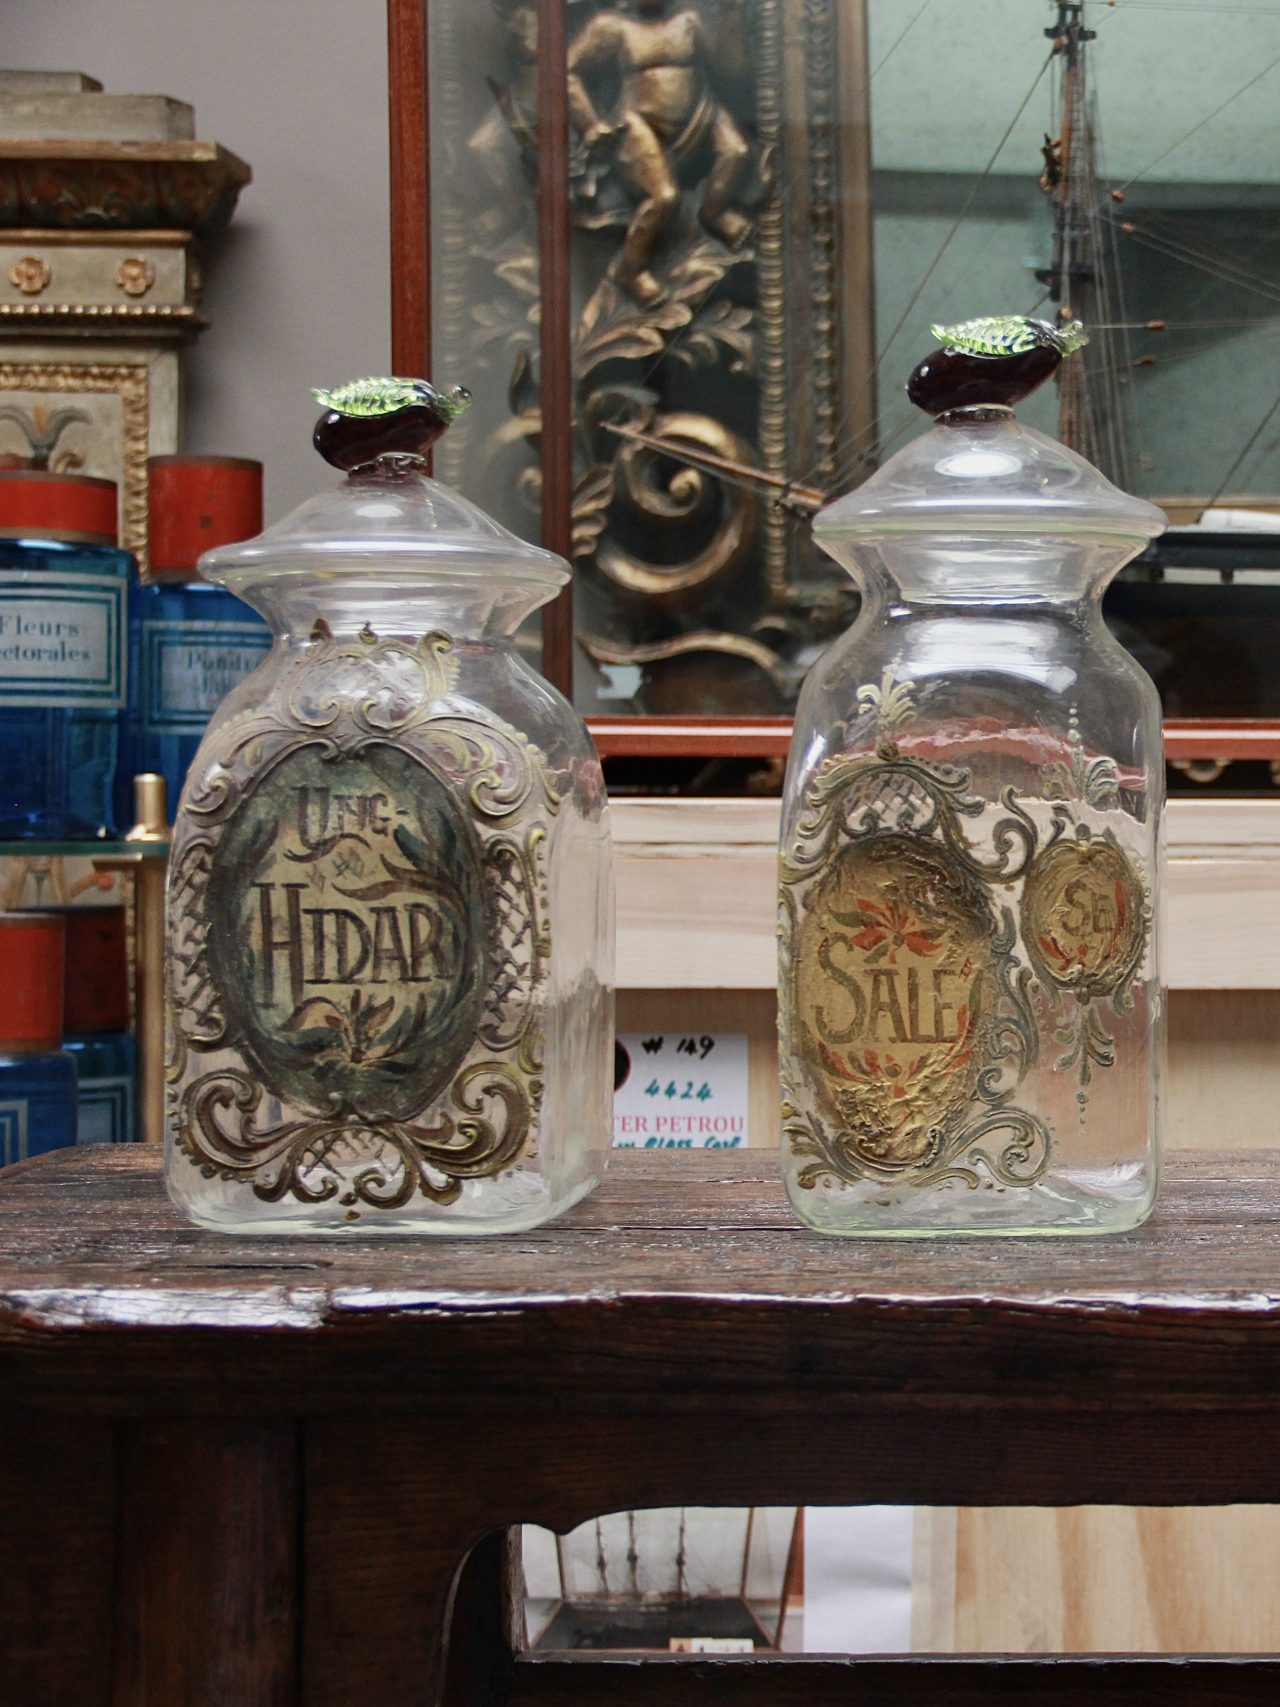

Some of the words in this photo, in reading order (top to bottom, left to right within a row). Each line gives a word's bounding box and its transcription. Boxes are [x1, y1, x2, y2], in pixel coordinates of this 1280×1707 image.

[250, 882, 456, 1010] HIDAR
[809, 931, 973, 1045] SALE
[655, 1116, 744, 1133] PETROU
